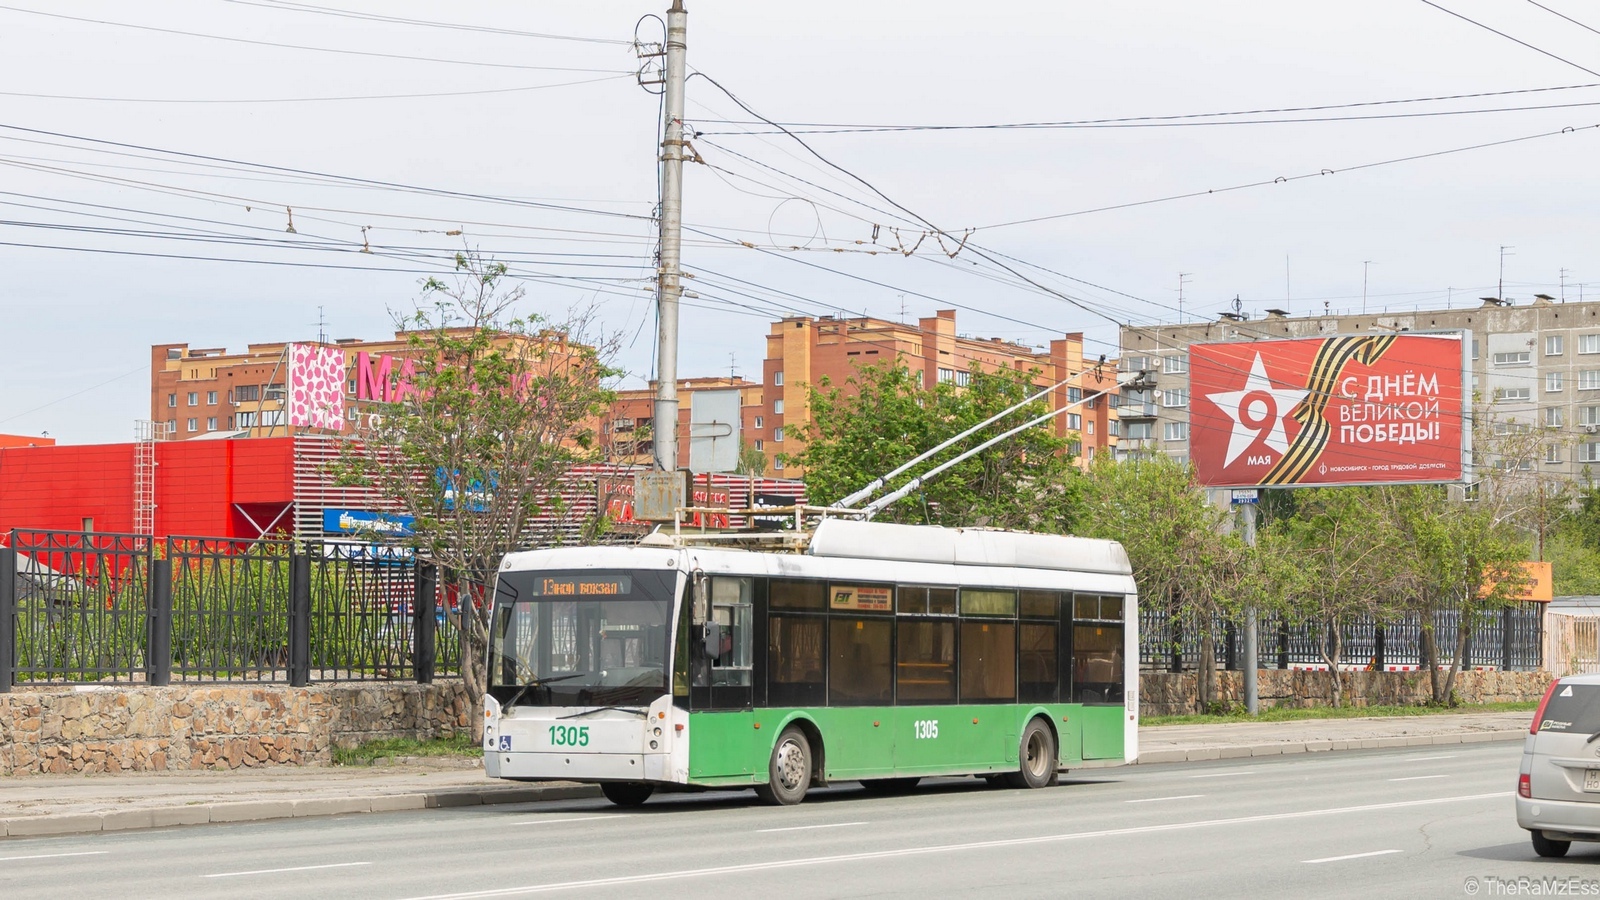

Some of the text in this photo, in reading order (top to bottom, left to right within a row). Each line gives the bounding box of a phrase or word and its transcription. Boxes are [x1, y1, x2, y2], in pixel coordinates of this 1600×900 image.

[1341, 371, 1439, 402] С ДНЁМ
[1238, 389, 1278, 444] 9
[1340, 397, 1439, 422] ВЕЛИКОЙ
[1340, 422, 1440, 445] ПОБЕДЫ!
[1247, 455, 1271, 466] МАЯ
[1391, 462, 1417, 471] ТРУДОВОЙ
[549, 725, 590, 747] 1305
[914, 719, 939, 739] 1305
